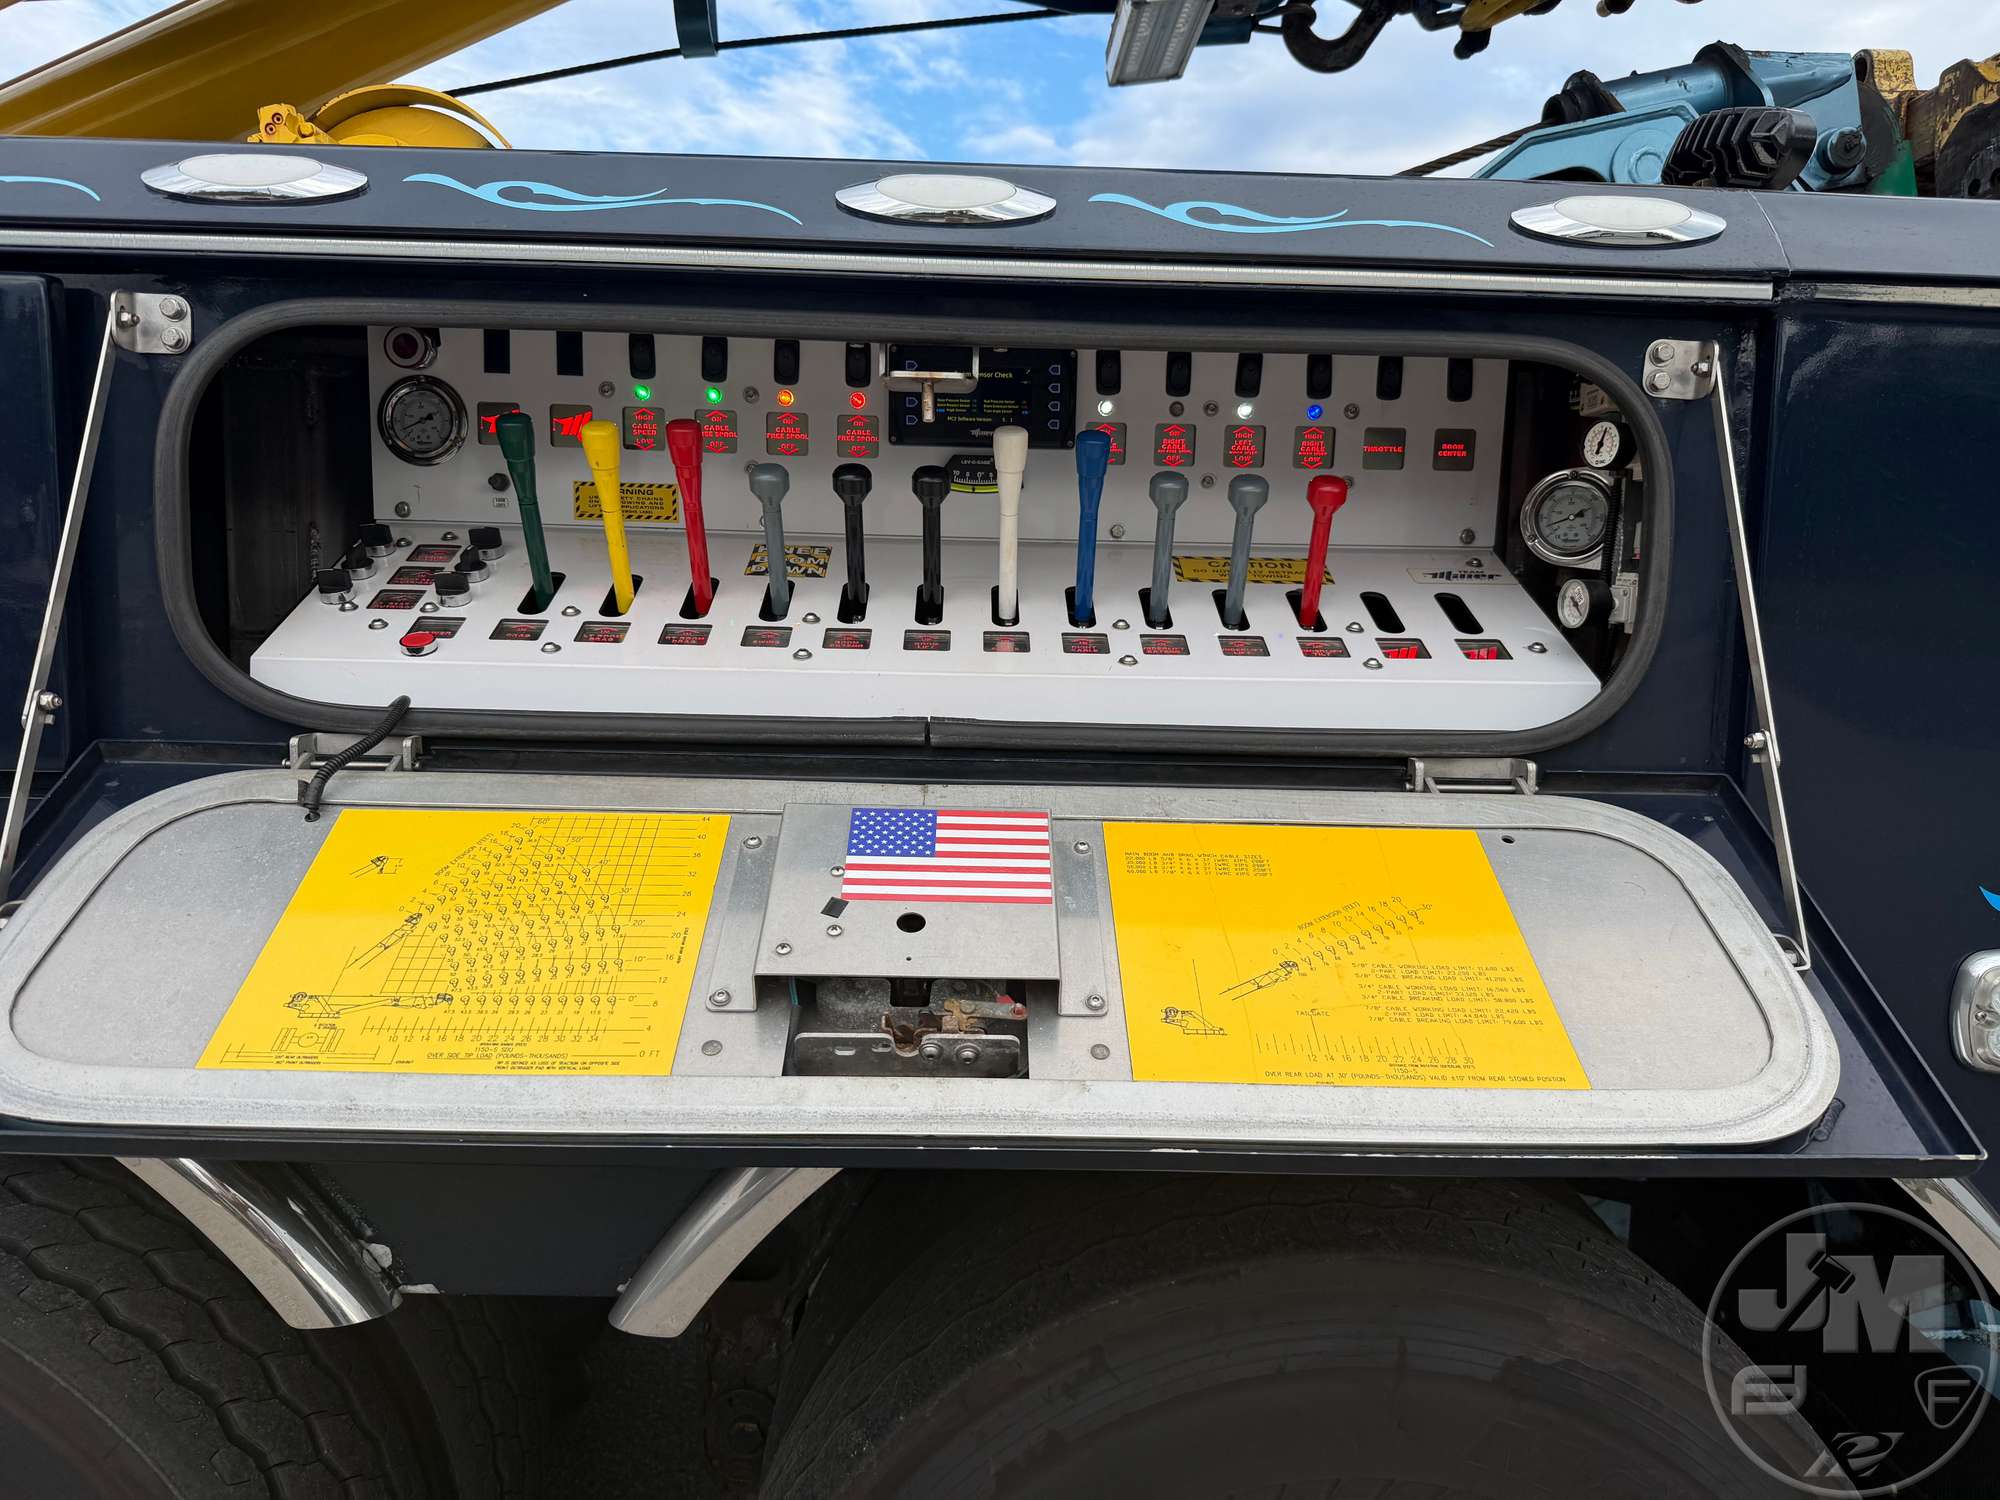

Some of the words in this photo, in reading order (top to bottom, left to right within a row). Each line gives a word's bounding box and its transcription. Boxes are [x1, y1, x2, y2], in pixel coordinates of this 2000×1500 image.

[977, 371, 993, 379] ensor
[755, 556, 826, 564] BOM
[1207, 560, 1293, 569] CATION
[751, 565, 827, 577] DWN
